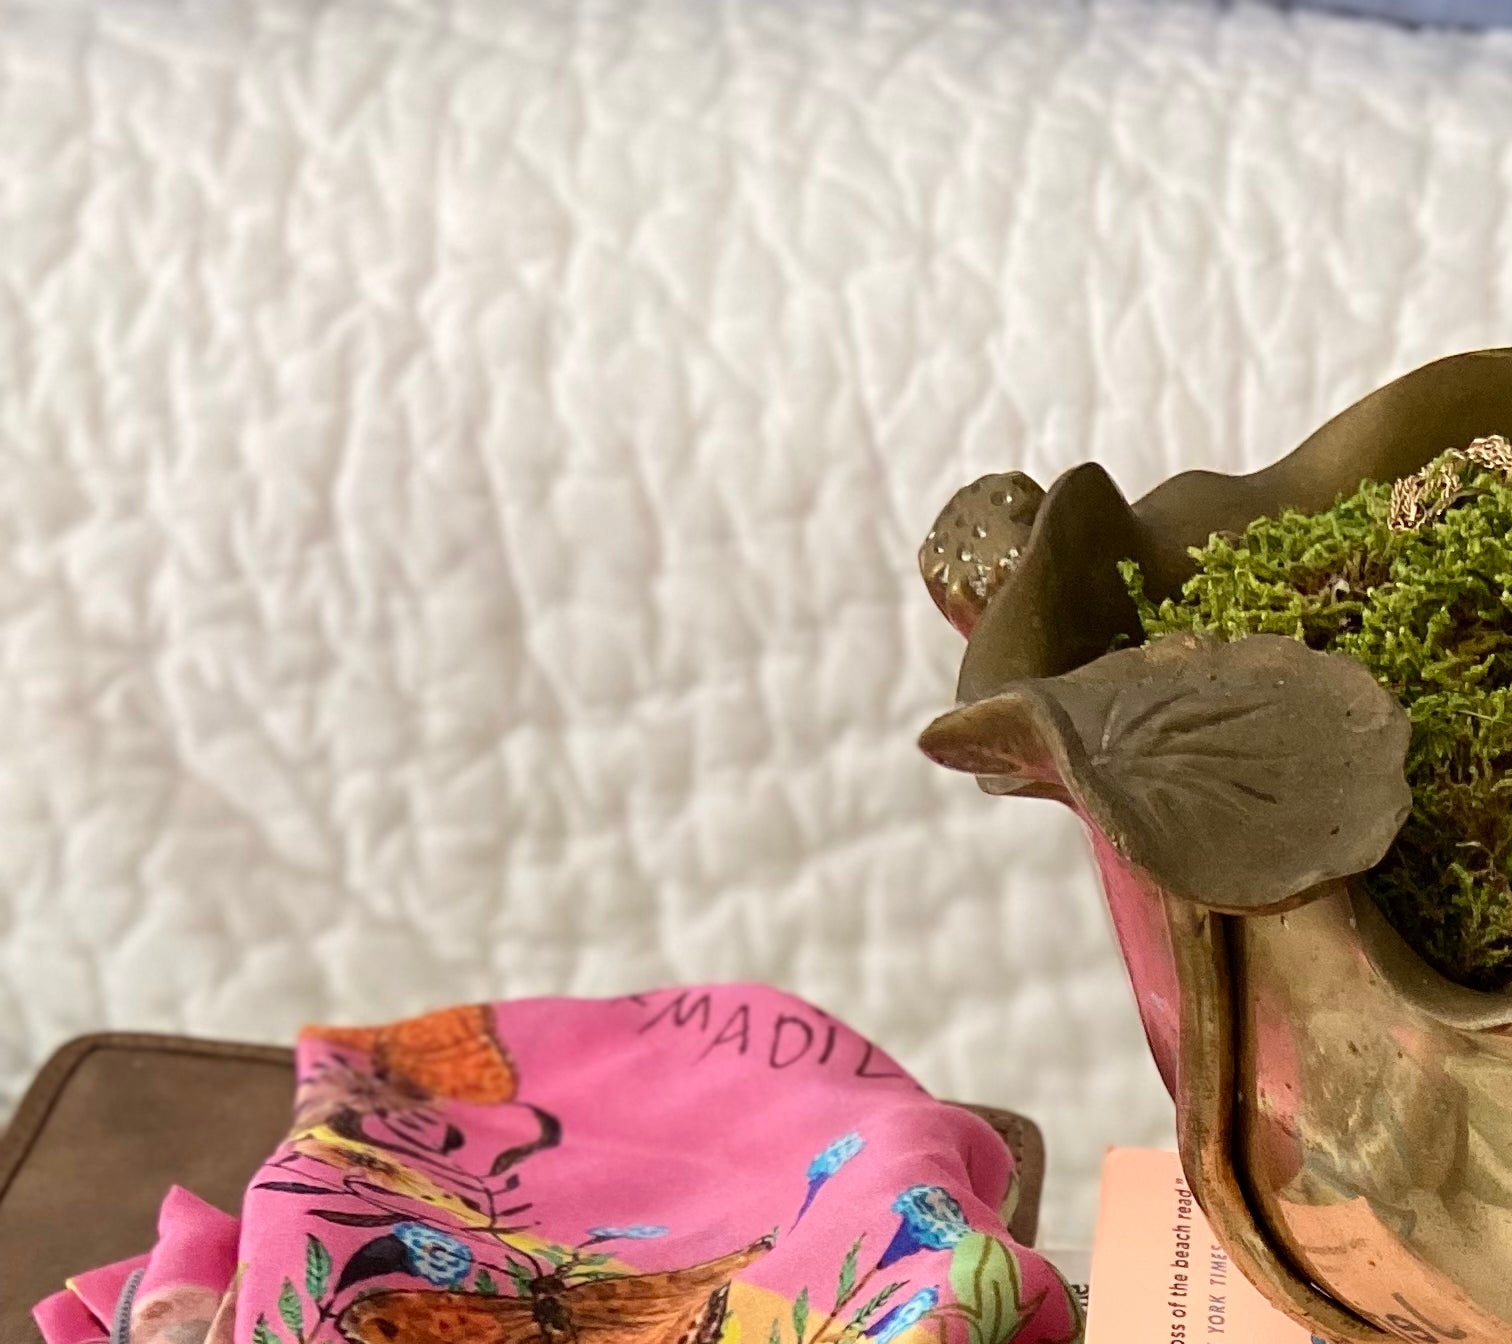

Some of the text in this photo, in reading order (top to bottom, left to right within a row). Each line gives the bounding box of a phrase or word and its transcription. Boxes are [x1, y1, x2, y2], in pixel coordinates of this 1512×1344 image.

[1170, 1225, 1191, 1269] beach
[1168, 1274, 1188, 1297] the
[1168, 1301, 1187, 1318] of
[1208, 1294, 1226, 1334] YORK
